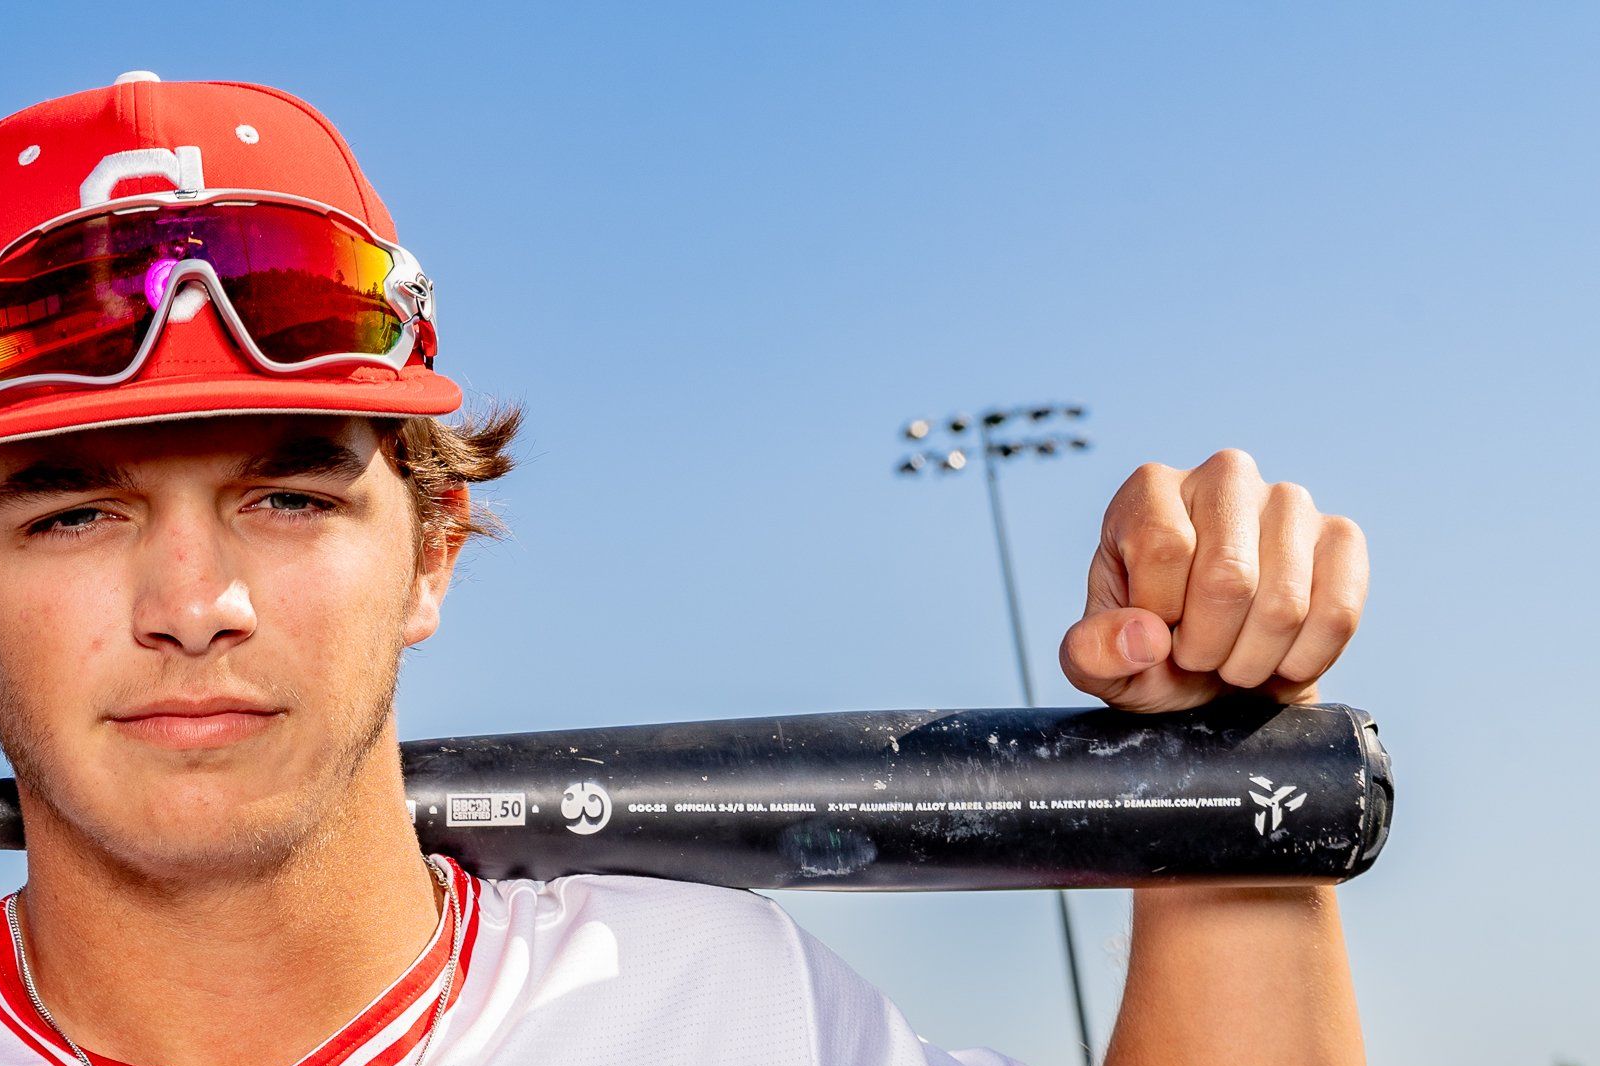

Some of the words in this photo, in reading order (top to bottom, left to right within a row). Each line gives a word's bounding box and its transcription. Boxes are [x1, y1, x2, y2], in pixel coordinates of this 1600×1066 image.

[674, 803, 716, 812] OFFICIAL
[718, 803, 745, 813] 2-5/8
[747, 803, 767, 812] DIA.
[770, 803, 816, 812] BASEBALL
[859, 802, 913, 812] ALUMINUM
[916, 802, 947, 811] ALLOY
[948, 801, 983, 811] BARREL
[985, 801, 1022, 810] DESIGN
[1029, 801, 1049, 810] U.S.
[1051, 800, 1086, 810] PATENT
[1088, 800, 1113, 809] NOS.
[1124, 798, 1242, 808] DEMARINI.COM/PATENTS
[452, 811, 491, 820] CERTIFIED
